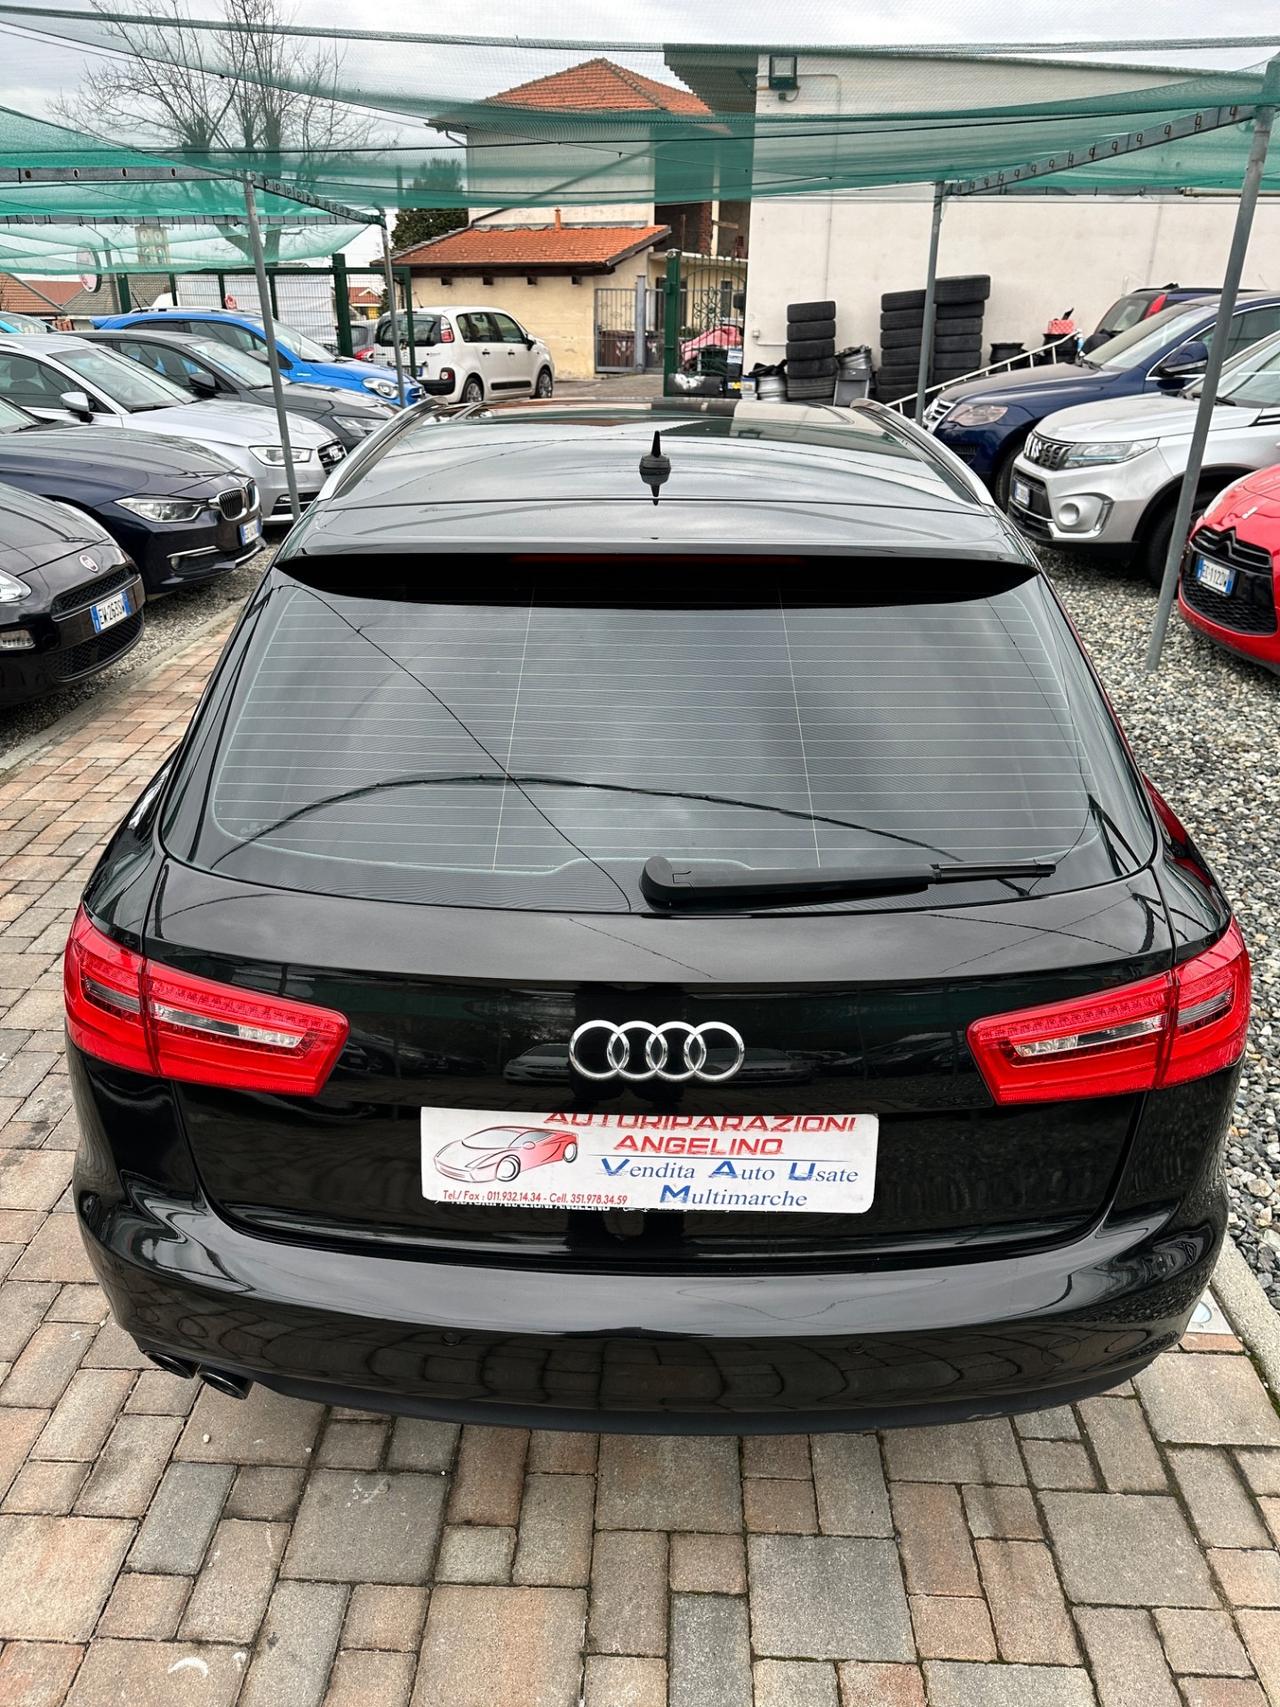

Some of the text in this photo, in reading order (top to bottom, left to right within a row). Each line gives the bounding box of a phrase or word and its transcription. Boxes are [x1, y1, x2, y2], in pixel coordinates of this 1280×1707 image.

[543, 1112, 857, 1132] AUTORIPARAZIONI
[614, 1134, 784, 1156] ANGELINO
[601, 1157, 859, 1183] Vendita Auto Usate
[463, 1190, 480, 1201] Fax
[486, 1190, 542, 1203] 011.932.14.34
[549, 1192, 569, 1204] Cell.
[570, 1193, 628, 1205] 351.978.34.59
[659, 1184, 808, 1207] Multimarche
